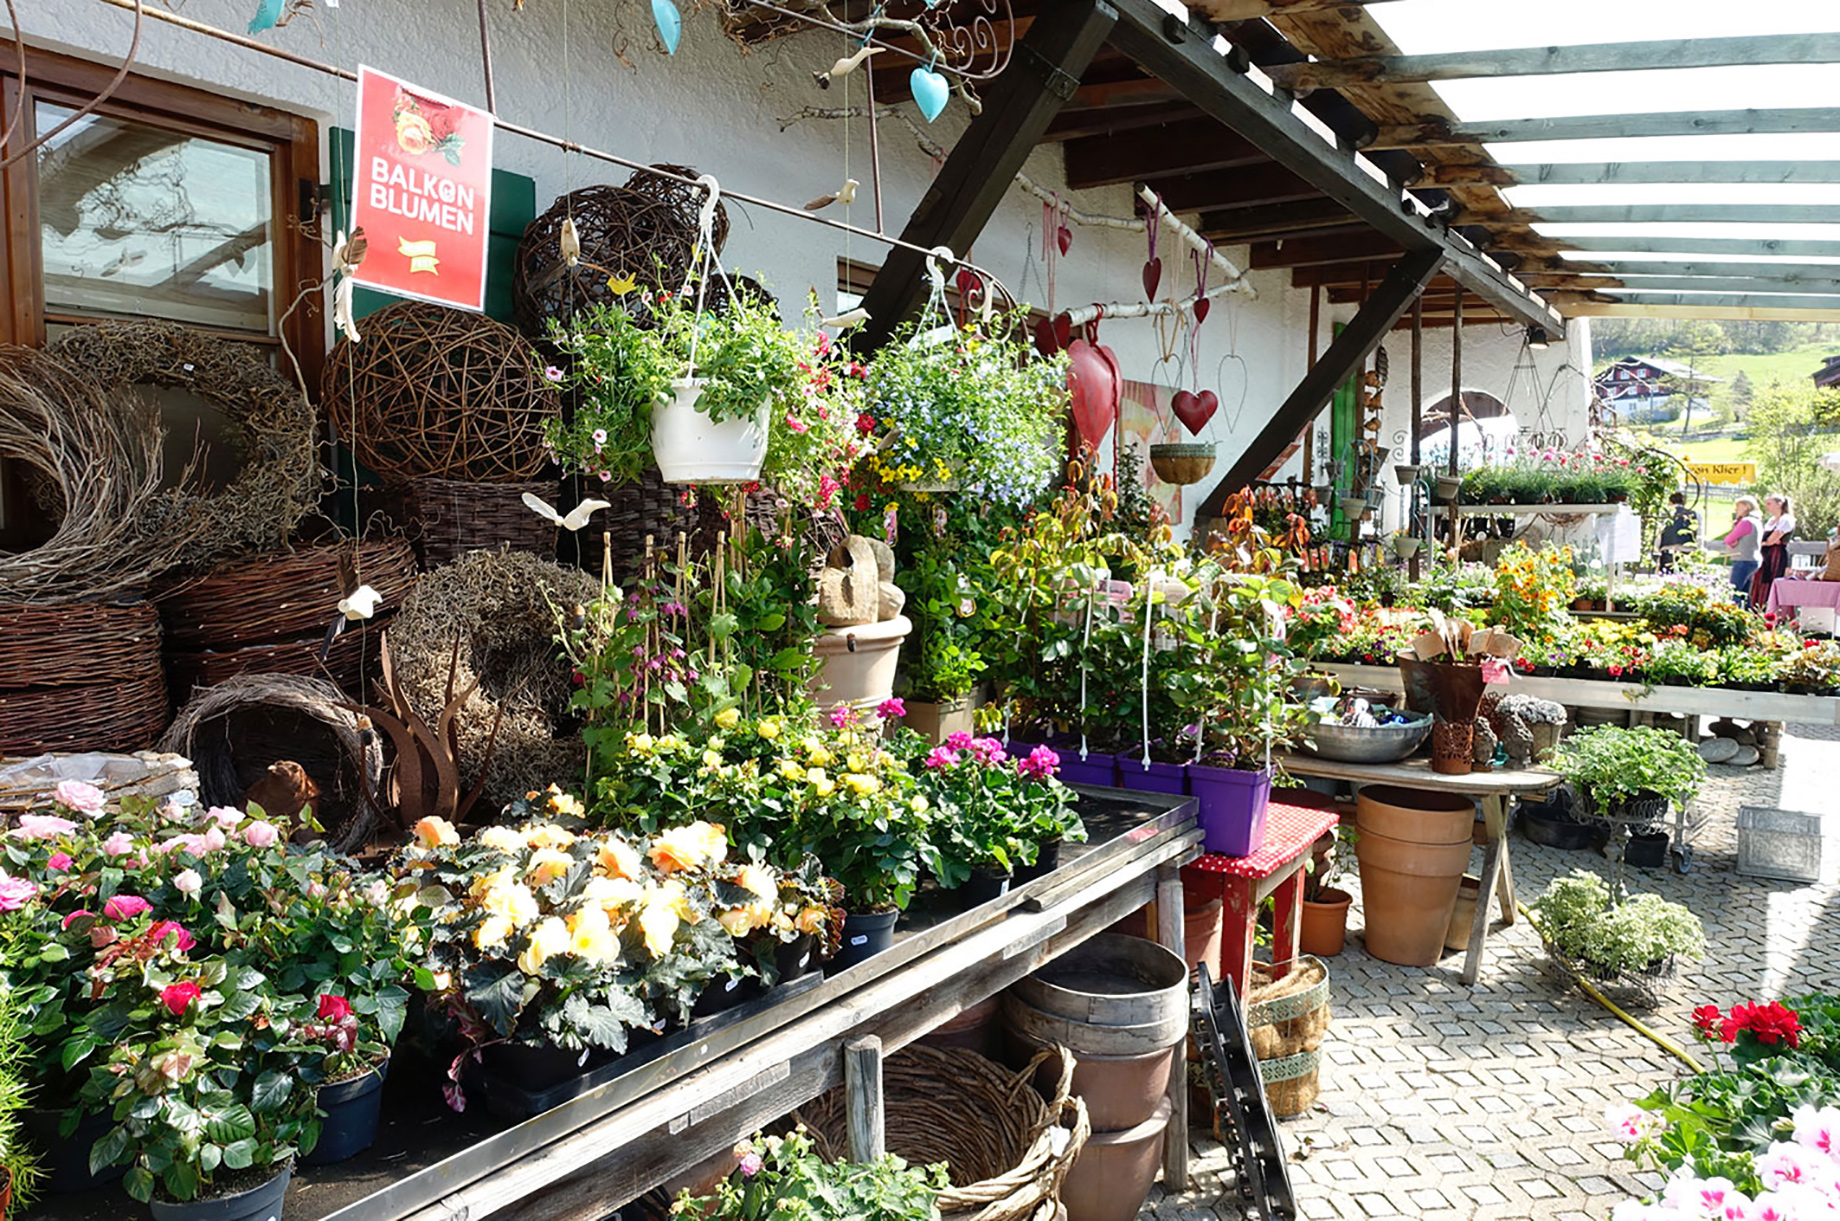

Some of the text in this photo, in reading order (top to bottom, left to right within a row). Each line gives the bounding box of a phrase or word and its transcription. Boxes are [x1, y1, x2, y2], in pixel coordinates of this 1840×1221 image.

[370, 183, 473, 235] BLUMEN
[371, 157, 474, 210] BALKON
[1713, 464, 1739, 475] Klier
